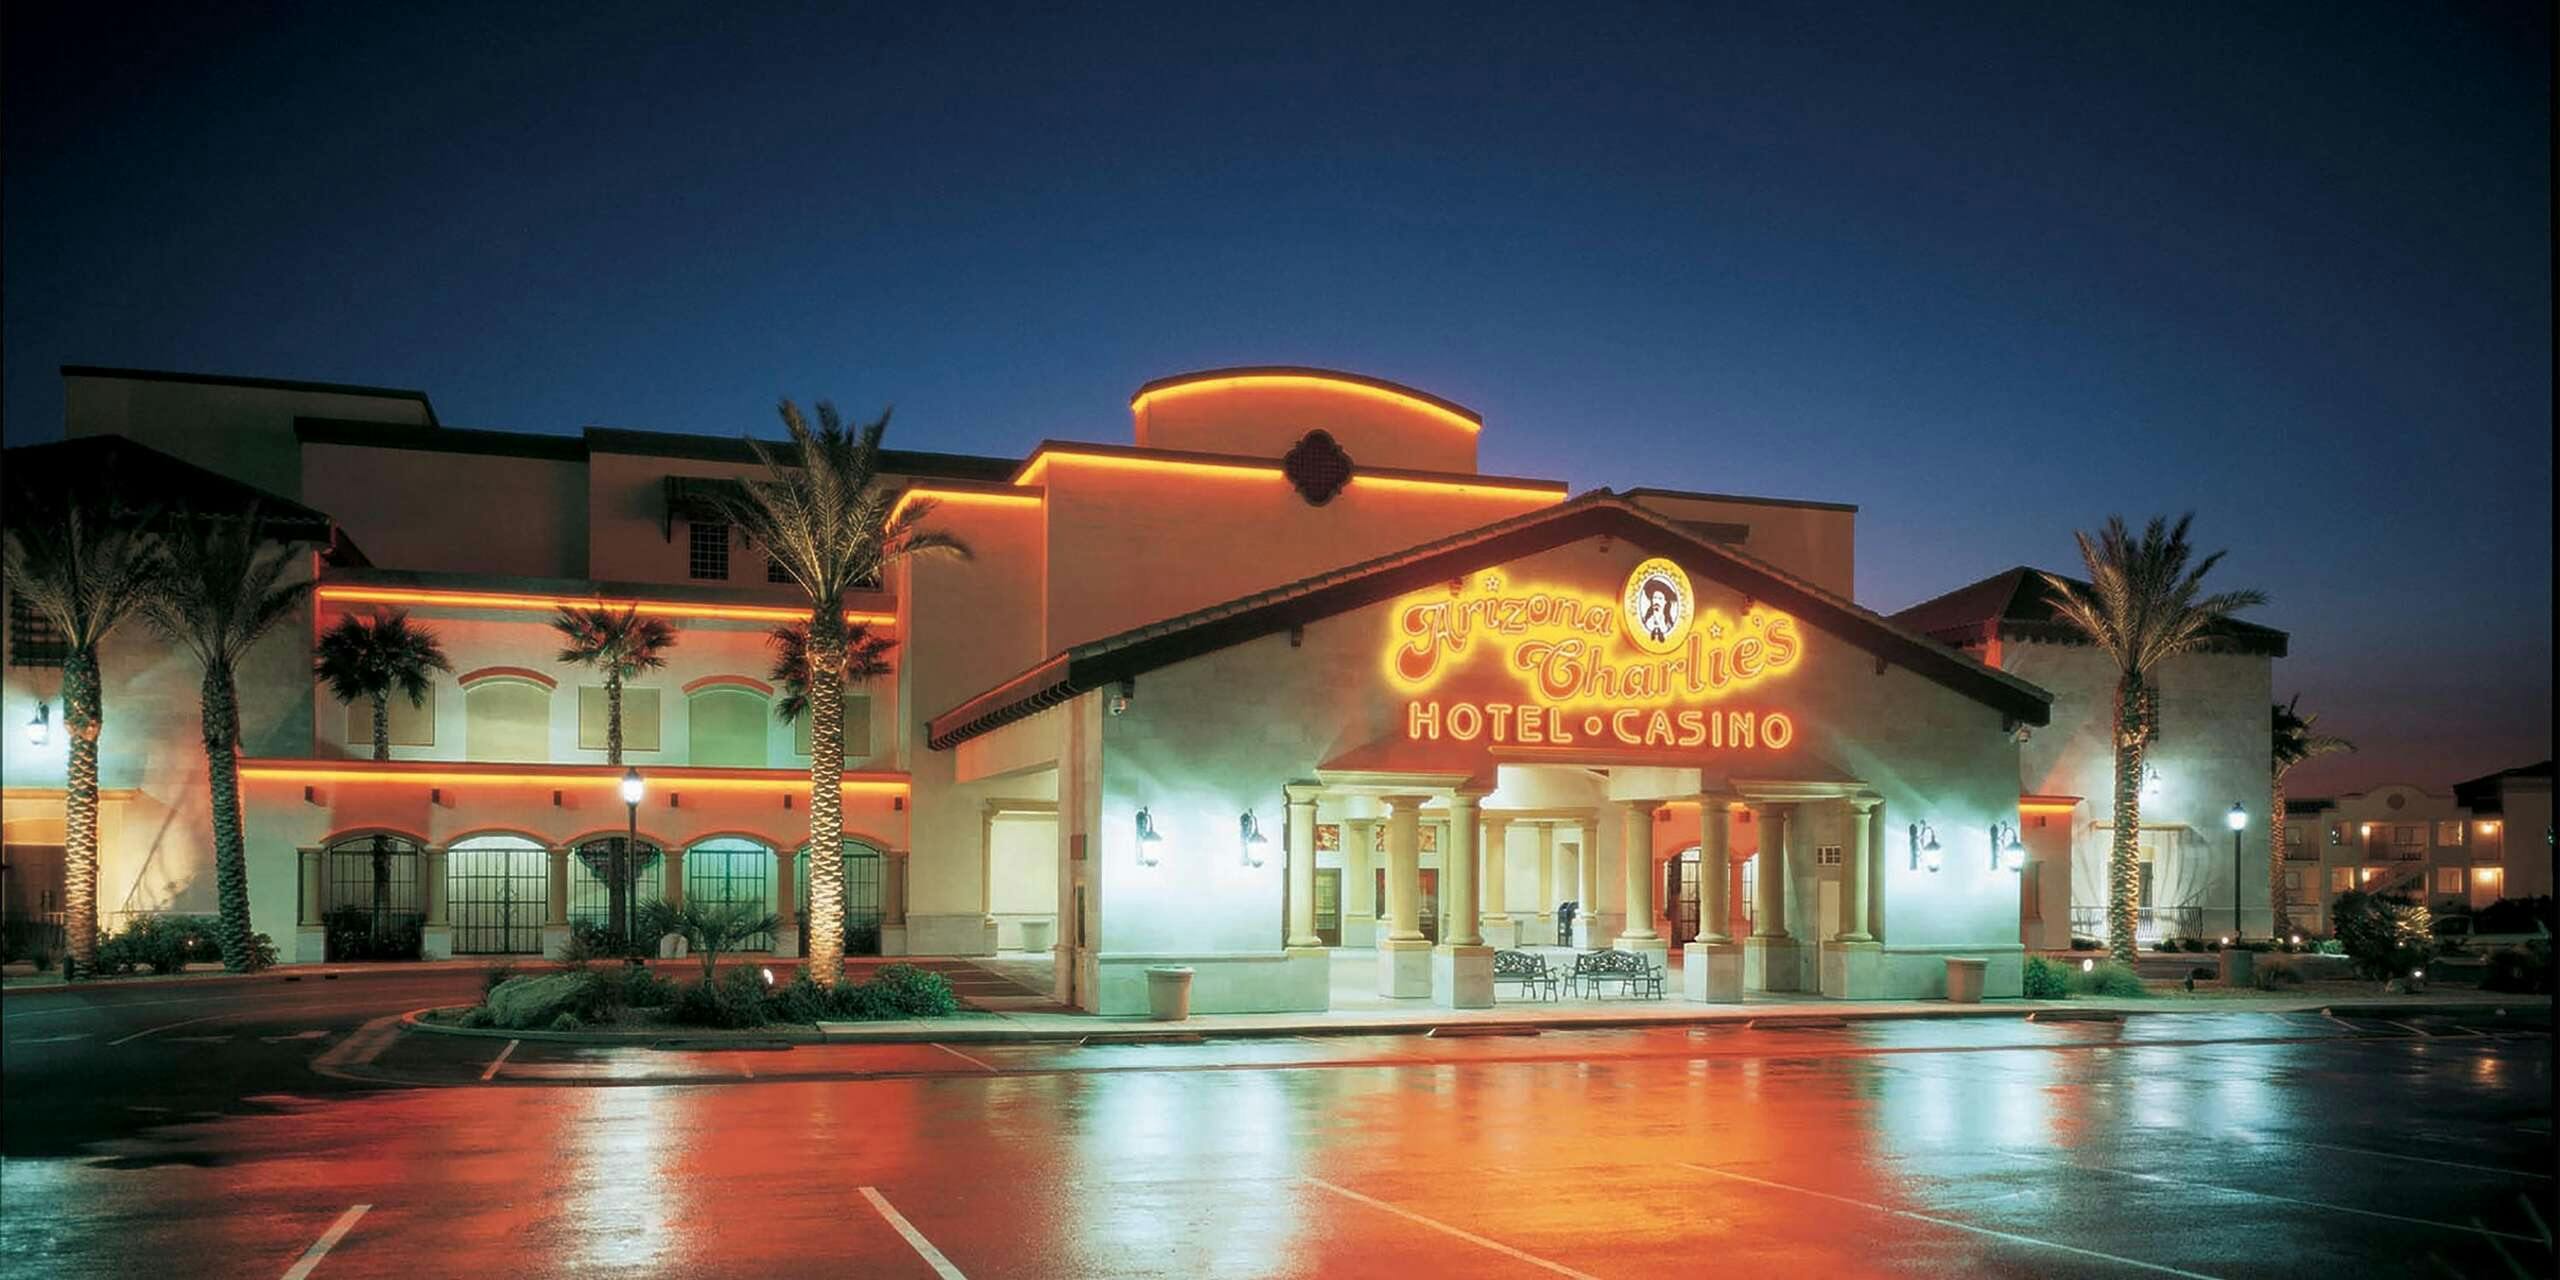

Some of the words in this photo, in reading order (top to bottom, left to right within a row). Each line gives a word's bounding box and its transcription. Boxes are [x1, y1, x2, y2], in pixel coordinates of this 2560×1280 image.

[1396, 576, 1613, 682] Arizona
[1515, 614, 1798, 700] Charlie's
[1408, 701, 1574, 745] HOTEL
[1612, 708, 1793, 749] CASINO
